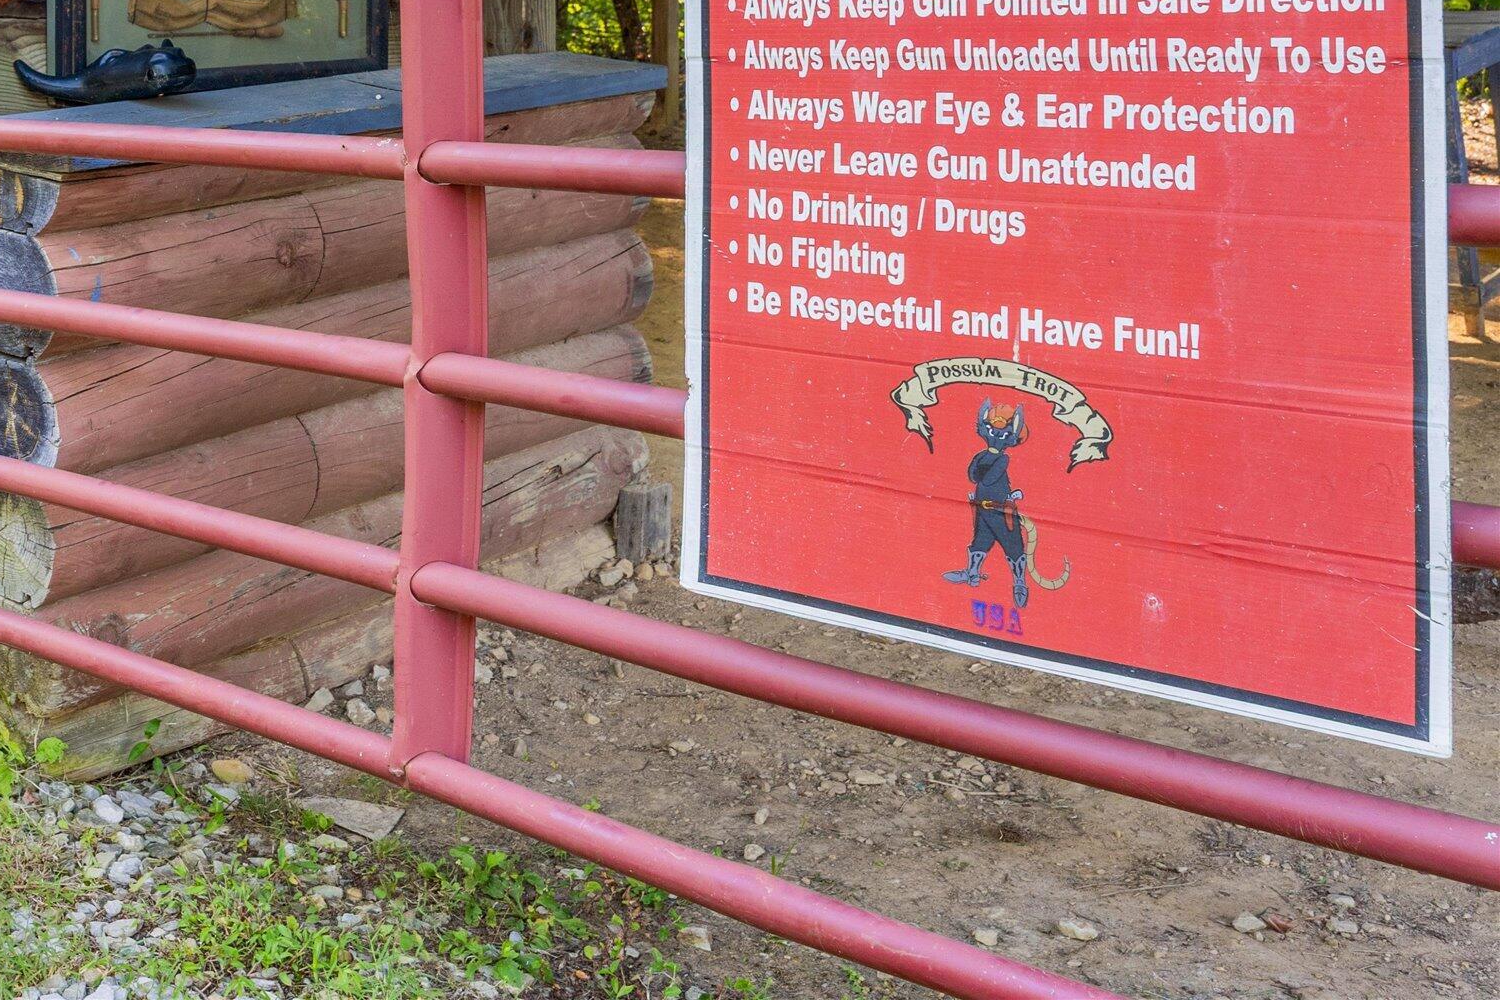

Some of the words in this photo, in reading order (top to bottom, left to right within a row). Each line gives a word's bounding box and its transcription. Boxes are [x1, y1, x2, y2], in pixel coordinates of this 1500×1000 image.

[744, 39, 823, 78] Always
[829, 39, 890, 78] Keep
[897, 38, 947, 72] Gun
[953, 37, 1081, 72] Unloaded
[1088, 37, 1158, 73] Until
[1166, 37, 1262, 83] Ready
[1270, 37, 1311, 74] To
[1320, 36, 1387, 75] Use
[747, 89, 845, 130] Always
[852, 90, 927, 125] Wear
[935, 92, 991, 135] Eye
[1000, 92, 1026, 128] &
[1036, 93, 1093, 129] Ear
[1103, 94, 1295, 135] Protection
[748, 139, 826, 174] Never
[833, 142, 918, 179] Leave
[927, 145, 988, 182] Gun
[998, 148, 1196, 191] Unattended
[748, 188, 783, 221] No
[792, 190, 908, 238] Drinking
[916, 197, 927, 231] /
[935, 198, 1027, 245] Drugs
[747, 233, 783, 266] No
[791, 236, 906, 286] Fighting
[747, 281, 782, 316] Be
[789, 285, 942, 333] Respectful
[951, 305, 1009, 340] and
[1020, 307, 1103, 350] Have
[1114, 316, 1200, 360] Fun!!
[926, 364, 1003, 383] POSSUM
[1017, 367, 1074, 403] TROT
[971, 599, 1023, 636] USA
